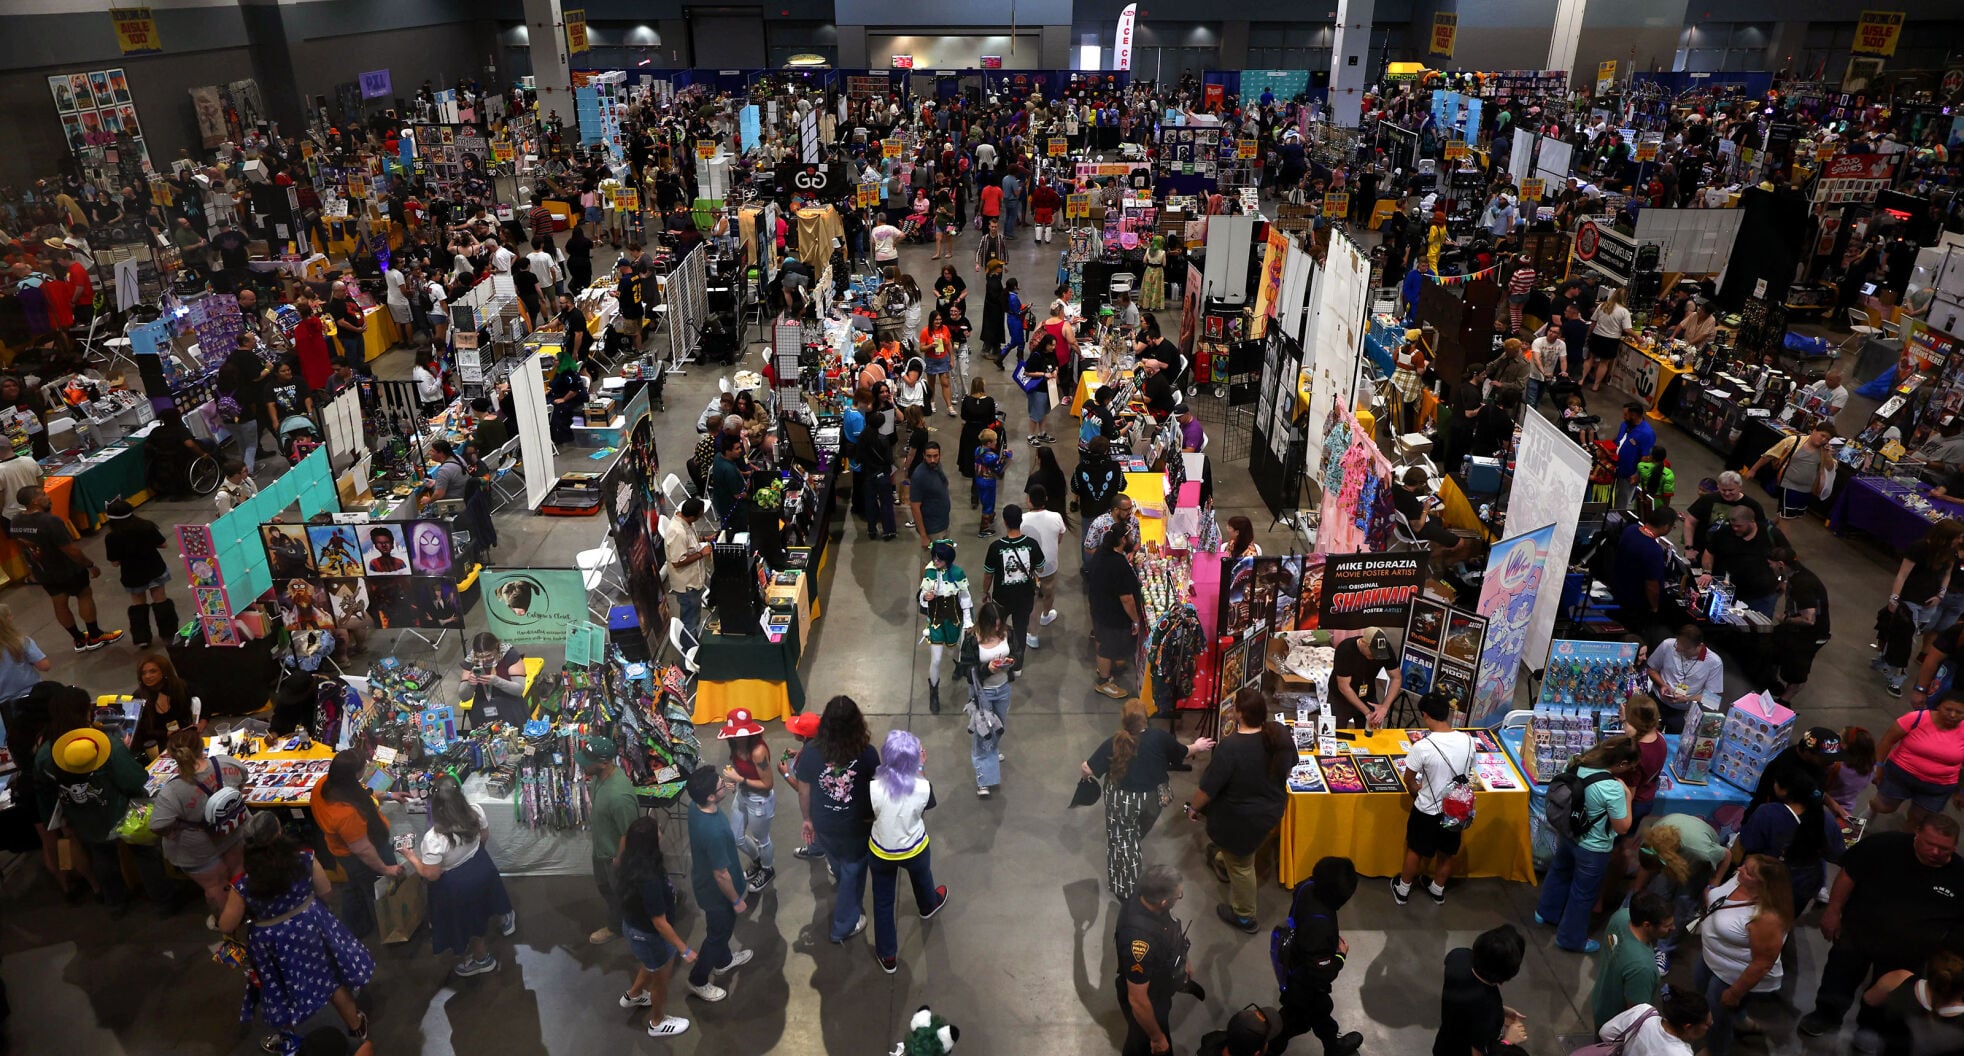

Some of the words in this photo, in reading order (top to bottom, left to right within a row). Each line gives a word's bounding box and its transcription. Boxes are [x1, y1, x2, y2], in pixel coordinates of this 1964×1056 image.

[120, 21, 150, 33] AISLE
[1122, 18, 1131, 44] ICE
[1435, 25, 1453, 38] AISLE
[1861, 26, 1894, 38] AISLE
[128, 33, 148, 45] 100
[1435, 37, 1449, 50] 400
[1862, 37, 1886, 49] 500
[1336, 562, 1363, 571] MIKE
[1365, 560, 1418, 570] DIGRAZIA
[1335, 570, 1361, 578] MOVIE
[1363, 569, 1390, 577] POSTER
[1391, 568, 1417, 576] ARTIST
[1348, 582, 1380, 590] ORIGINAL
[1405, 653, 1433, 669] DEAD
[1441, 667, 1471, 681] MOON
